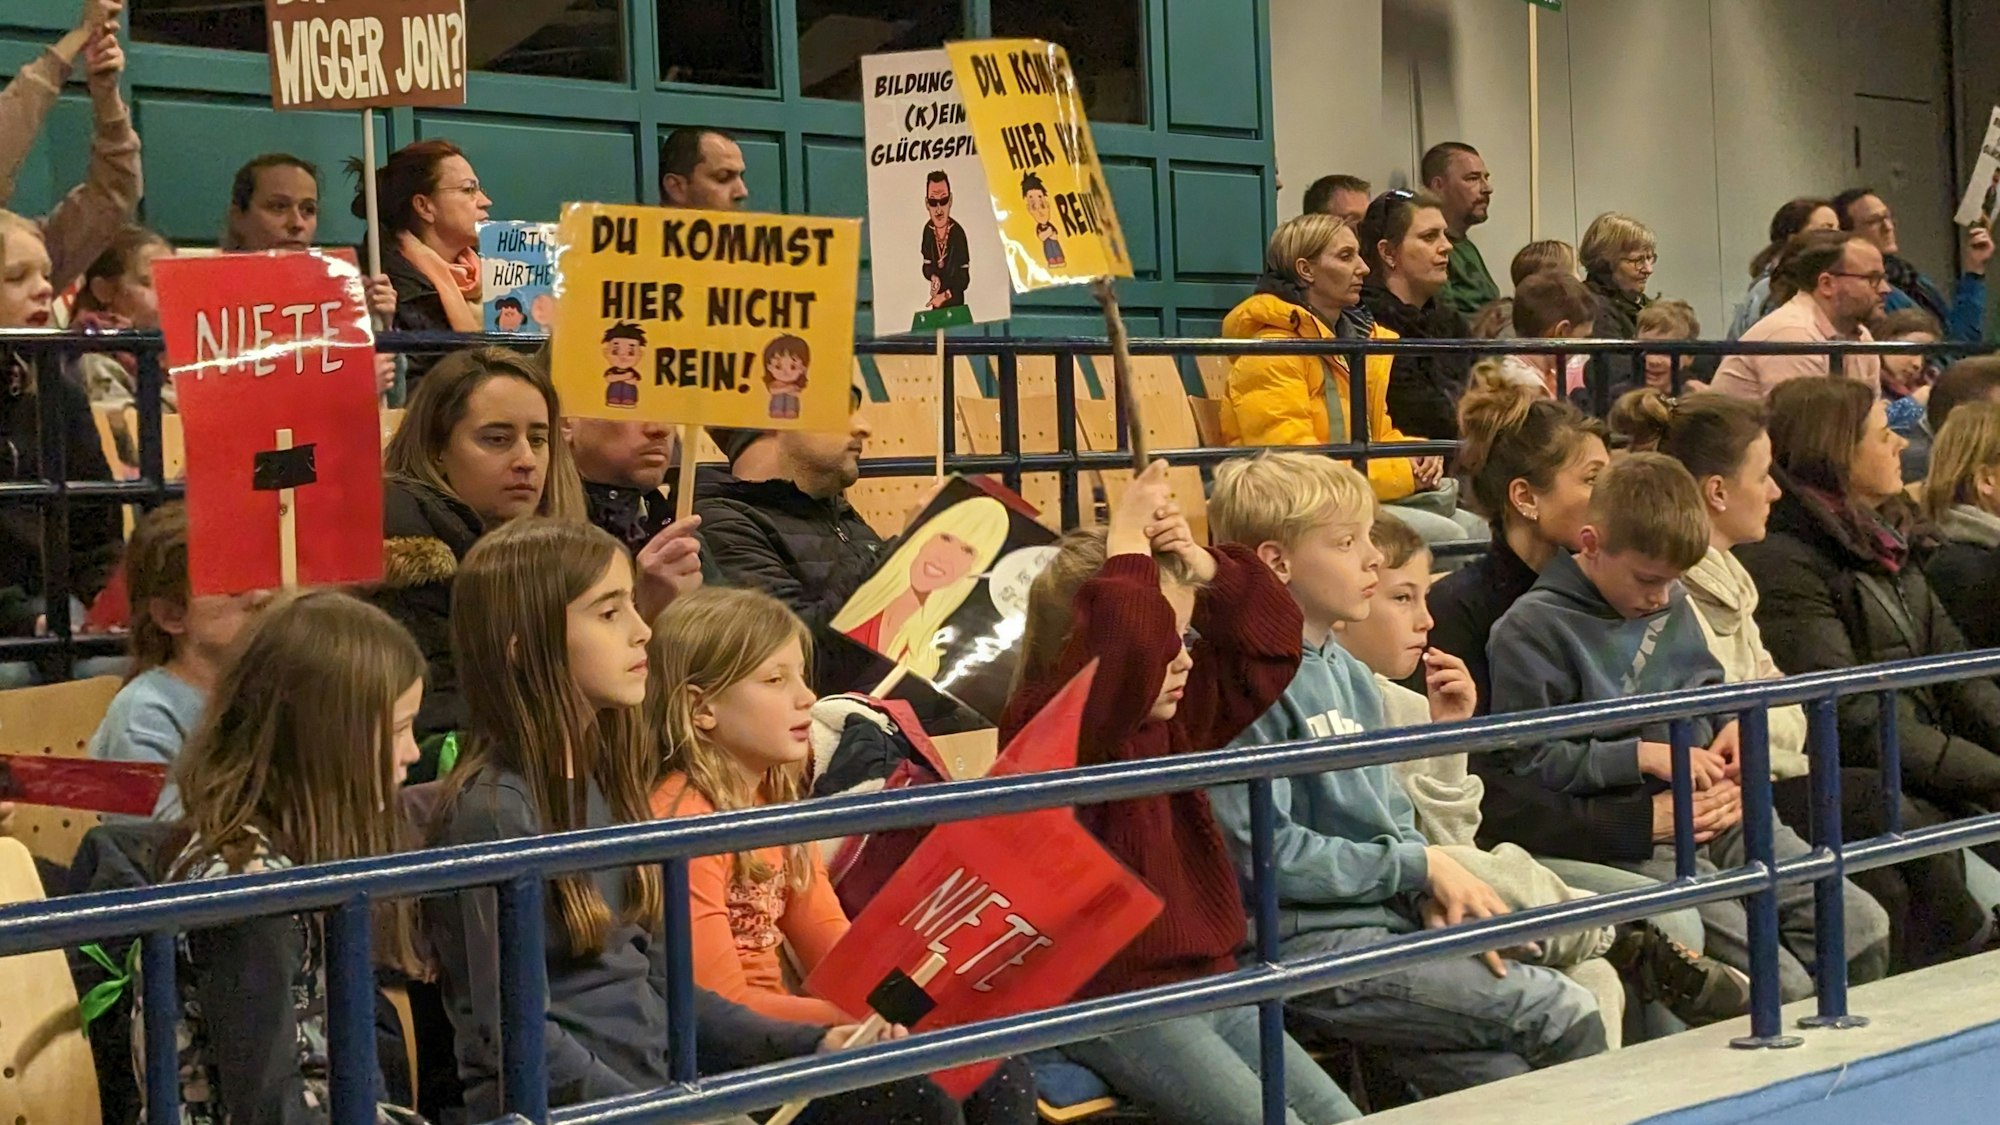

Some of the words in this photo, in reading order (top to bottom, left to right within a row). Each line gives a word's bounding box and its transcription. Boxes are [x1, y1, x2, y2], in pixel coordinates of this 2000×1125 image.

[273, 17, 389, 105] WIGGER
[395, 12, 462, 93] JON?
[970, 53, 1007, 98] DU
[874, 70, 954, 98] BILDUNG
[904, 101, 967, 133] (K)EIN
[1001, 122, 1055, 170] HIER
[592, 215, 638, 255] DU
[661, 218, 834, 267] KOMMST
[602, 280, 684, 321] HIER
[707, 286, 817, 329] NICHT
[195, 300, 344, 380] NIETE
[655, 346, 756, 394] REIN!
[898, 866, 1054, 992] NIETE
